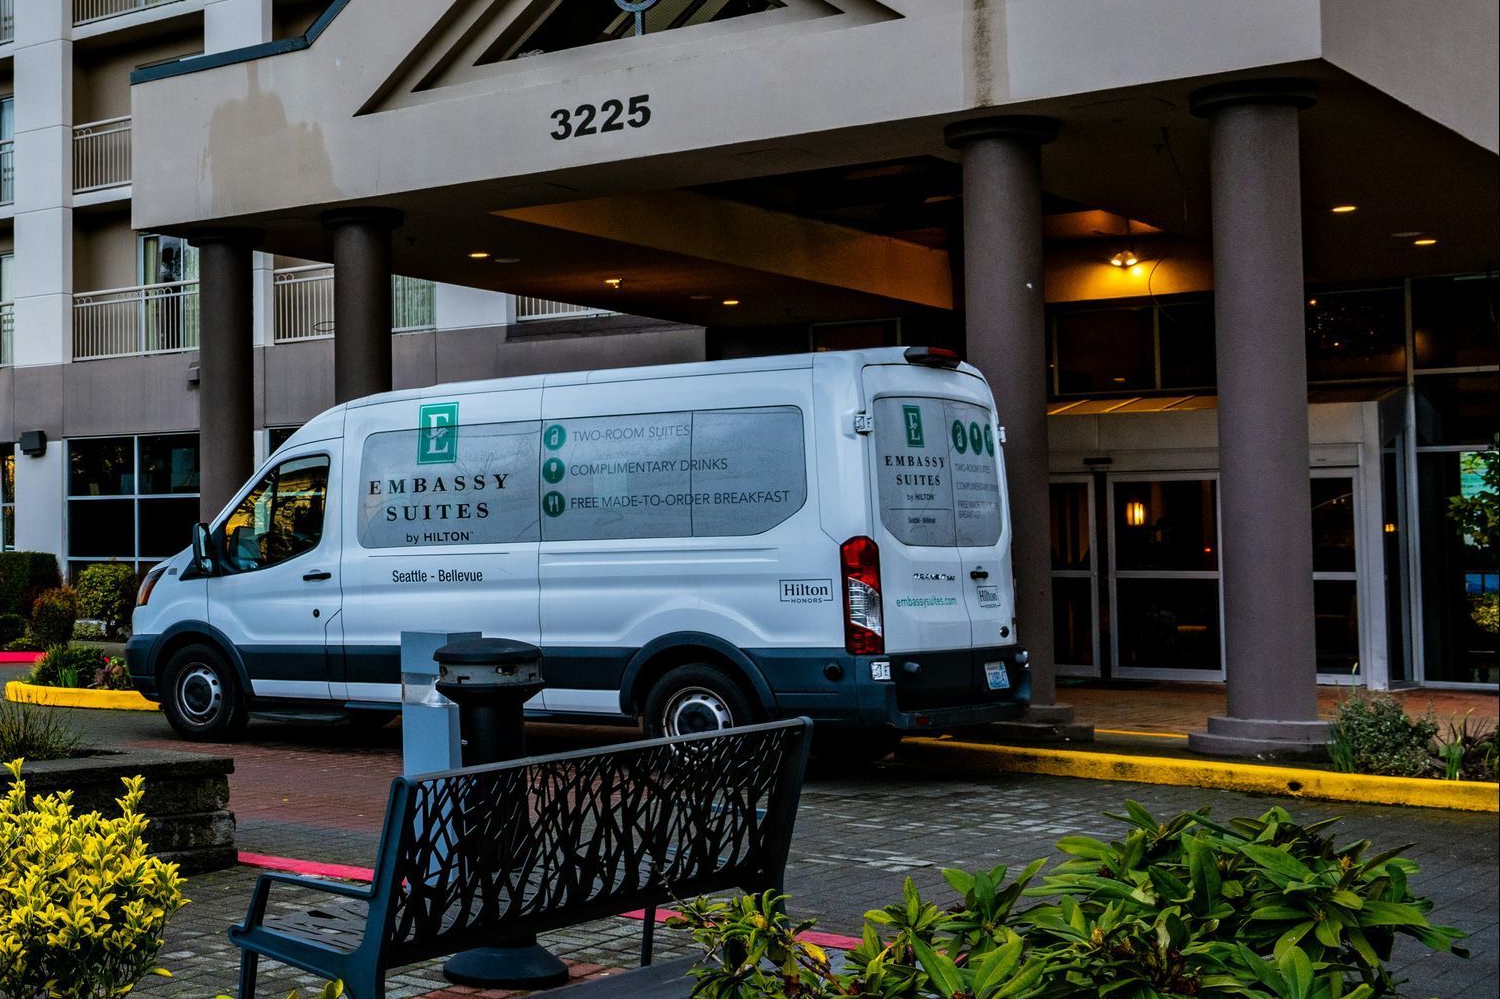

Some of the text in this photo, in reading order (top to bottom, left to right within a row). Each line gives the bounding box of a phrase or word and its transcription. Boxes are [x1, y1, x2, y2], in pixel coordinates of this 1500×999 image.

[550, 94, 651, 140] 3225
[572, 425, 690, 441] TWO-ROOM SUITES
[570, 458, 728, 476] COMPLIMENTARY DRINKS
[884, 456, 945, 467] EMBASSY
[368, 473, 509, 495] EMBASSY
[896, 475, 940, 486] SUITES
[571, 490, 790, 509] FREE MADE-TO-ORDER BREAKFAST
[386, 502, 489, 521] SUITES
[406, 533, 419, 544] by
[392, 570, 428, 582] Seattle
[438, 570, 483, 582] Bellevue
[784, 584, 828, 596] Hilton
